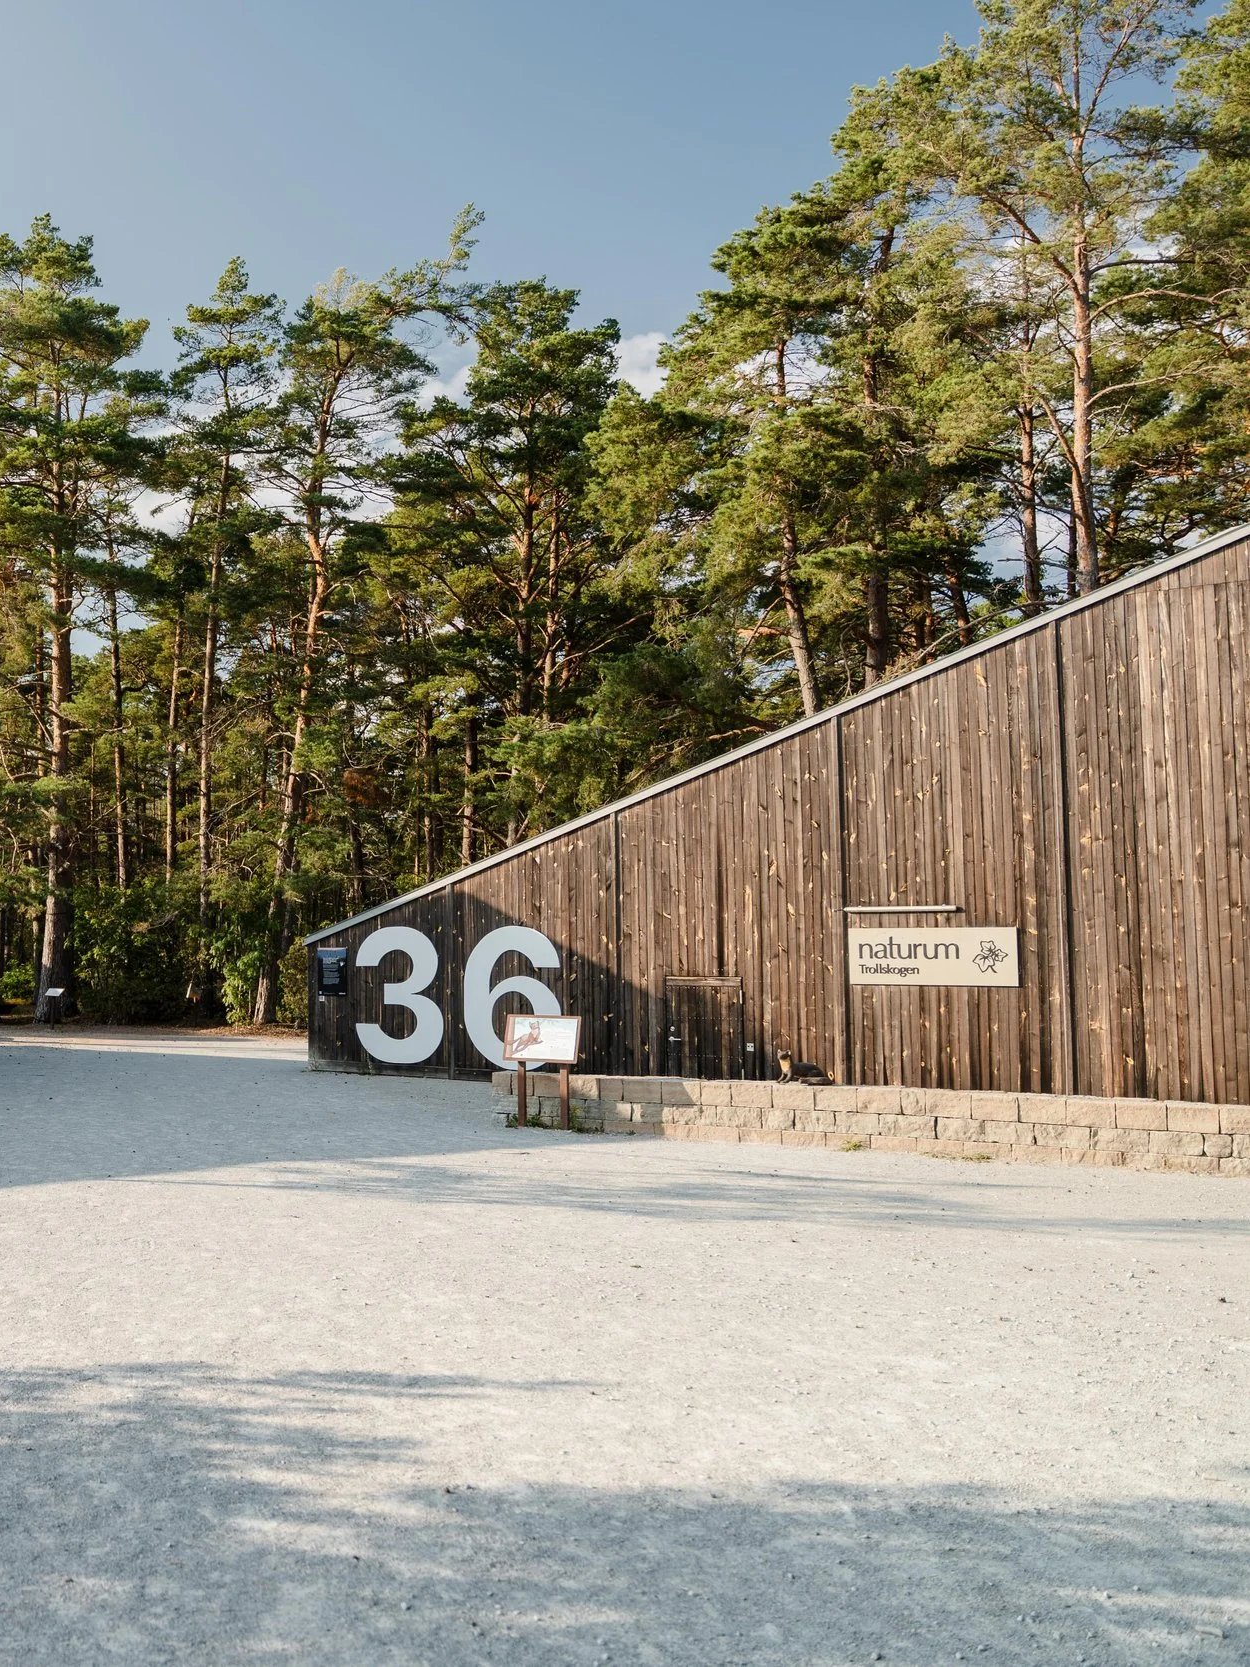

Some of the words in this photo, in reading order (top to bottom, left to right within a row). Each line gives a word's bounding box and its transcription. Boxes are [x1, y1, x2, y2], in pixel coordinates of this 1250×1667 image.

[858, 936, 959, 959] naturum
[858, 964, 920, 977] Trollskogen
[356, 926, 561, 1071] 36
